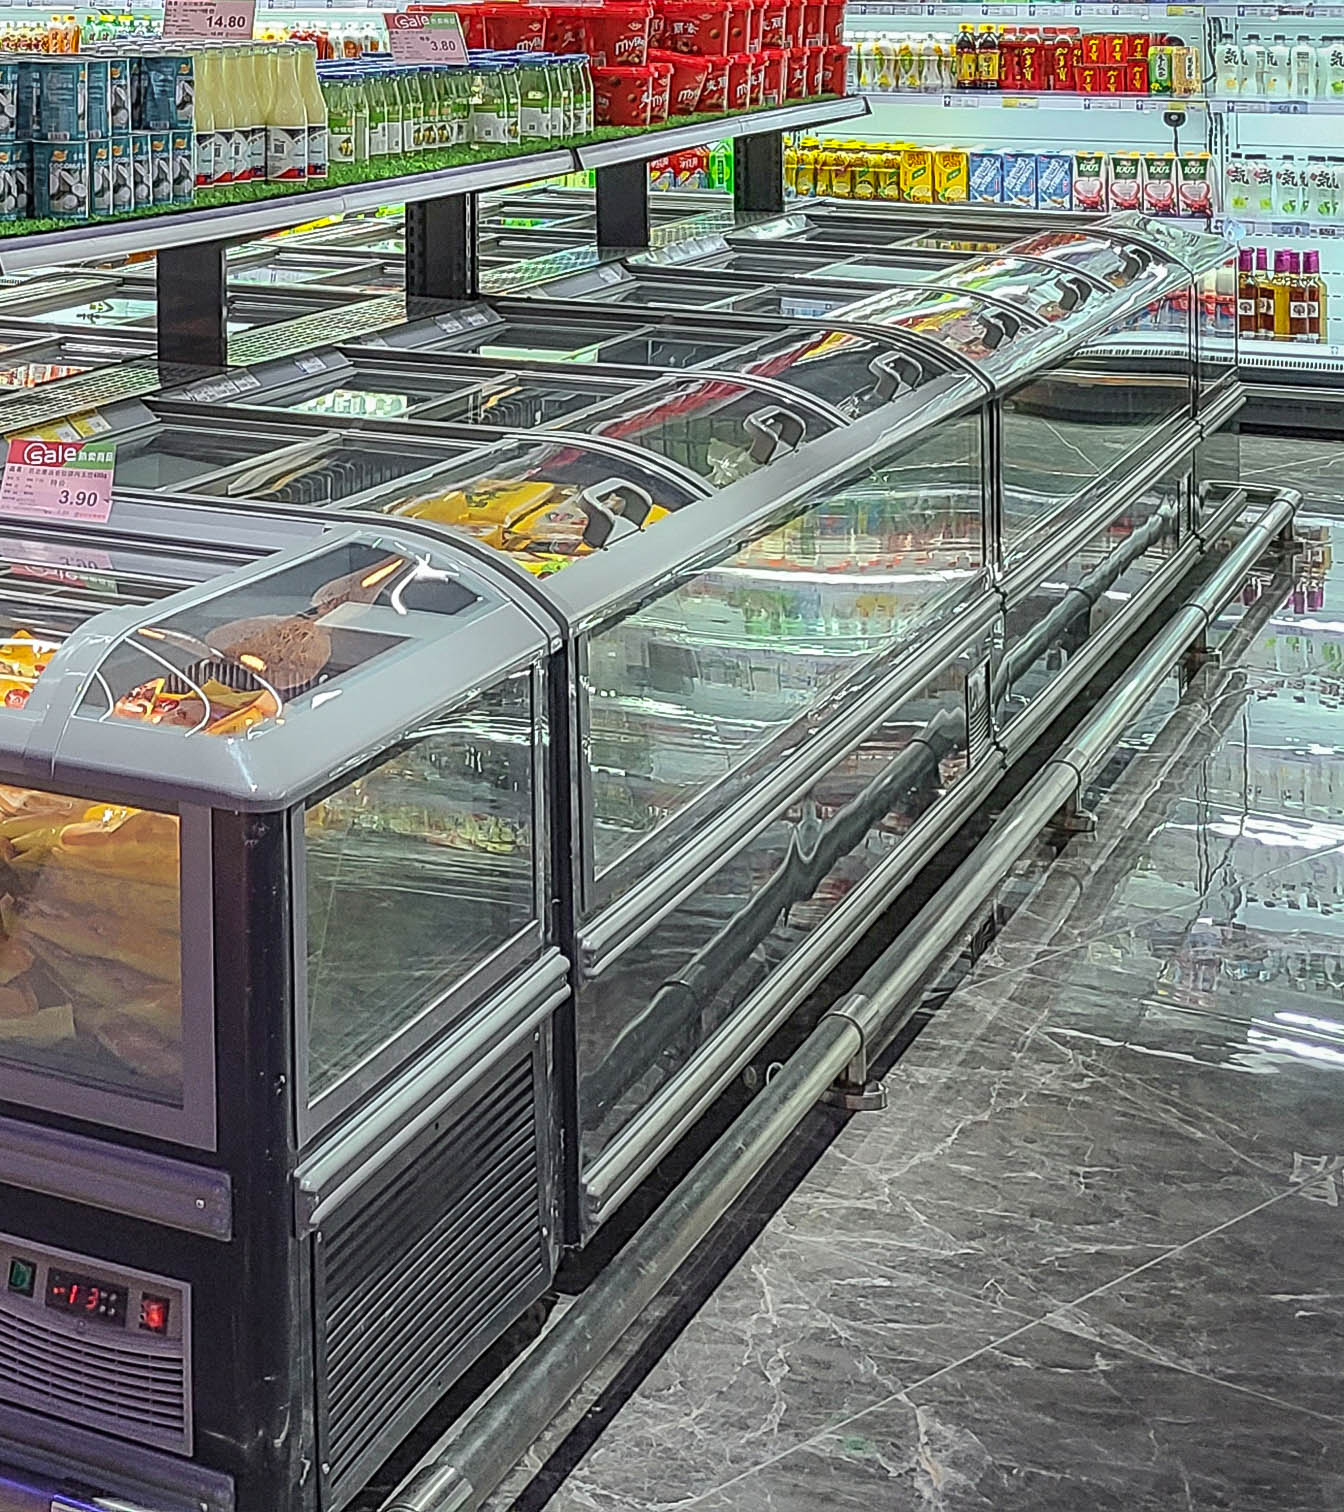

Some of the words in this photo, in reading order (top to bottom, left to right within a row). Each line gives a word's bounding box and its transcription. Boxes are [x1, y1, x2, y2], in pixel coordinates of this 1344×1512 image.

[206, 15, 246, 28] 14.80
[430, 40, 456, 51] 3.80
[58, 489, 98, 507] 3.90
